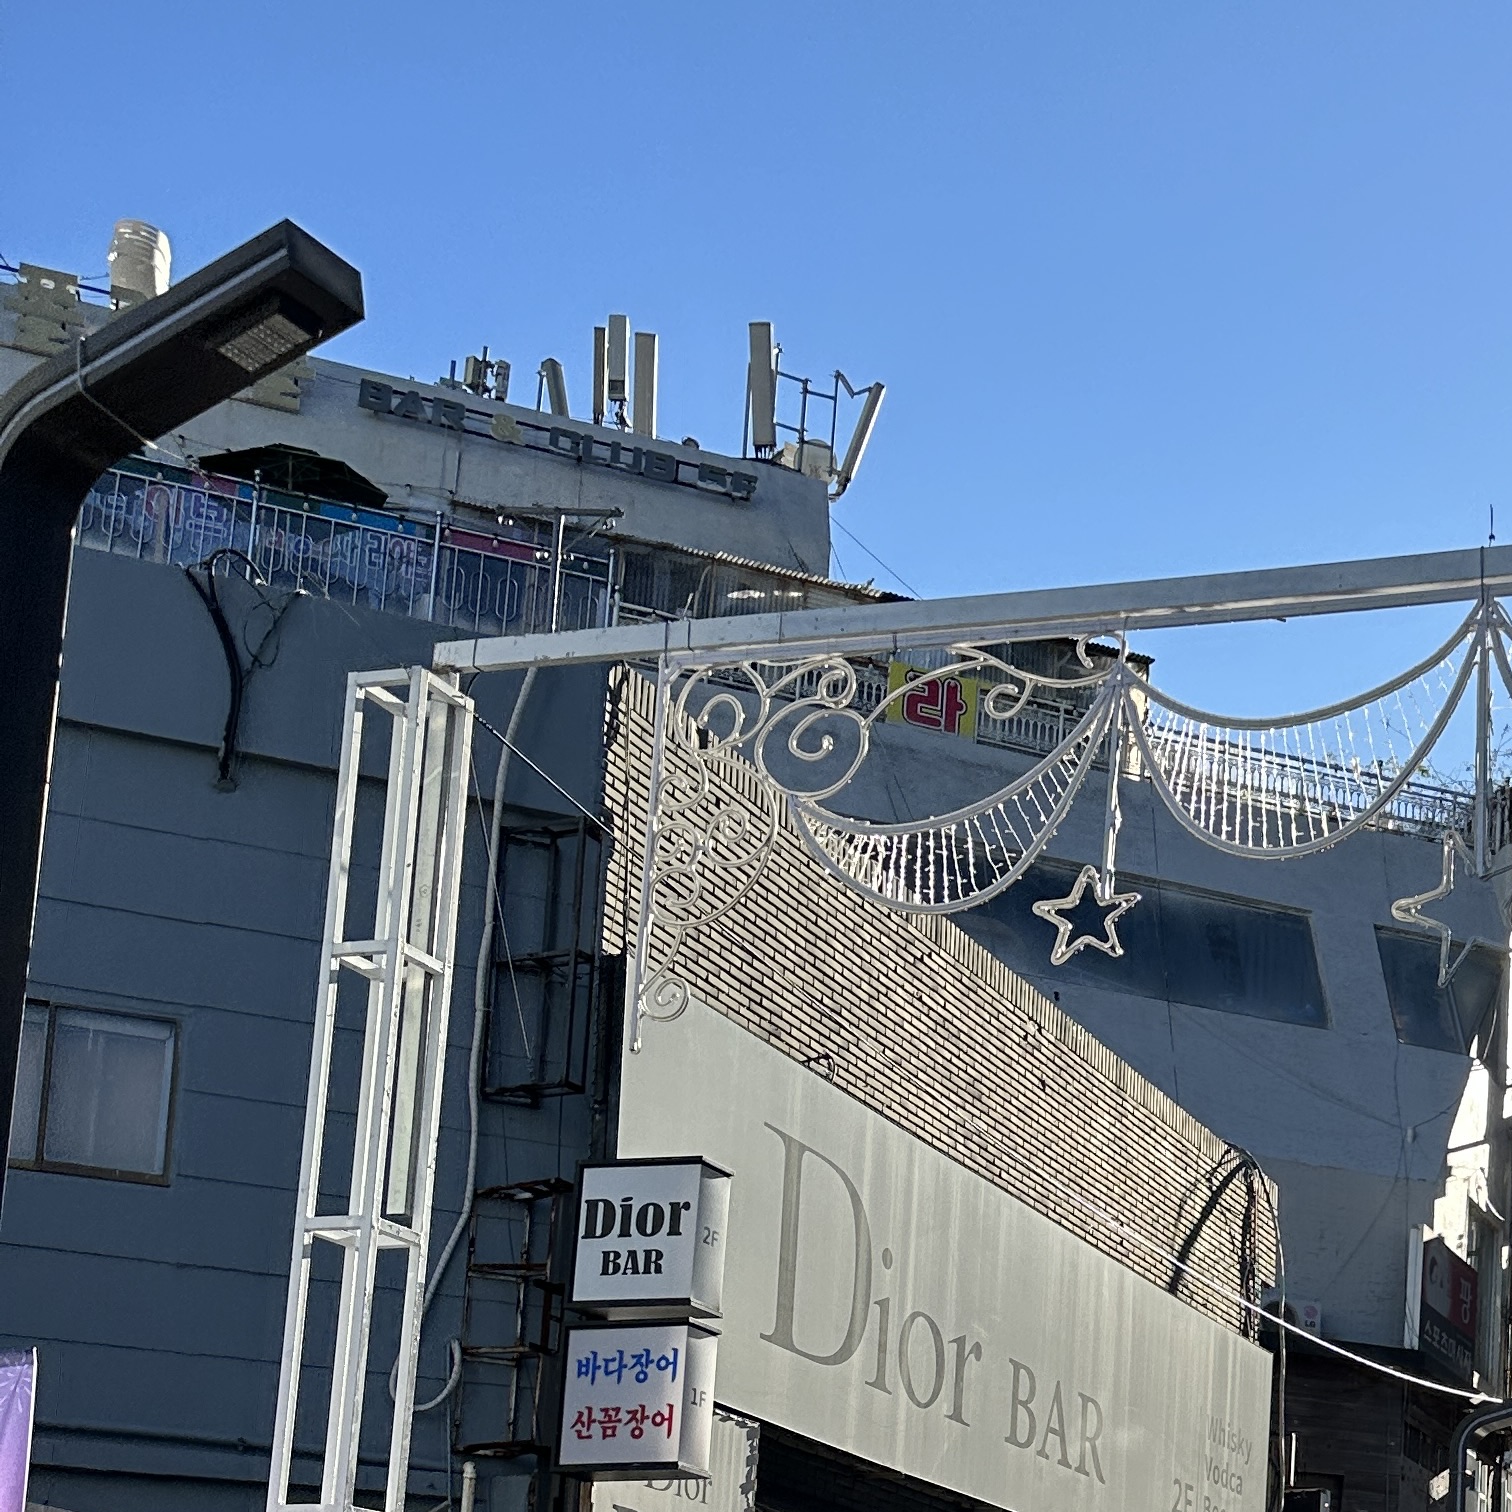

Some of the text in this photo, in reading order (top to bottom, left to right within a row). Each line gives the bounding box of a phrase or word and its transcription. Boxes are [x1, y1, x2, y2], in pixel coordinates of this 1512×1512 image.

[359, 378, 465, 431] BAR
[549, 427, 677, 483] CLUB
[581, 1196, 691, 1239] Dior
[702, 1226, 719, 1247] 2F
[600, 1248, 664, 1276] BAR
[759, 1121, 982, 1427] Dior
[576, 1347, 680, 1385] 바다장어
[689, 1386, 707, 1408] 1F
[570, 1403, 675, 1440] 산꼼장어
[1004, 1357, 1105, 1485] BAR
[1206, 1413, 1252, 1466] Whisky
[1204, 1453, 1244, 1496] Vodca
